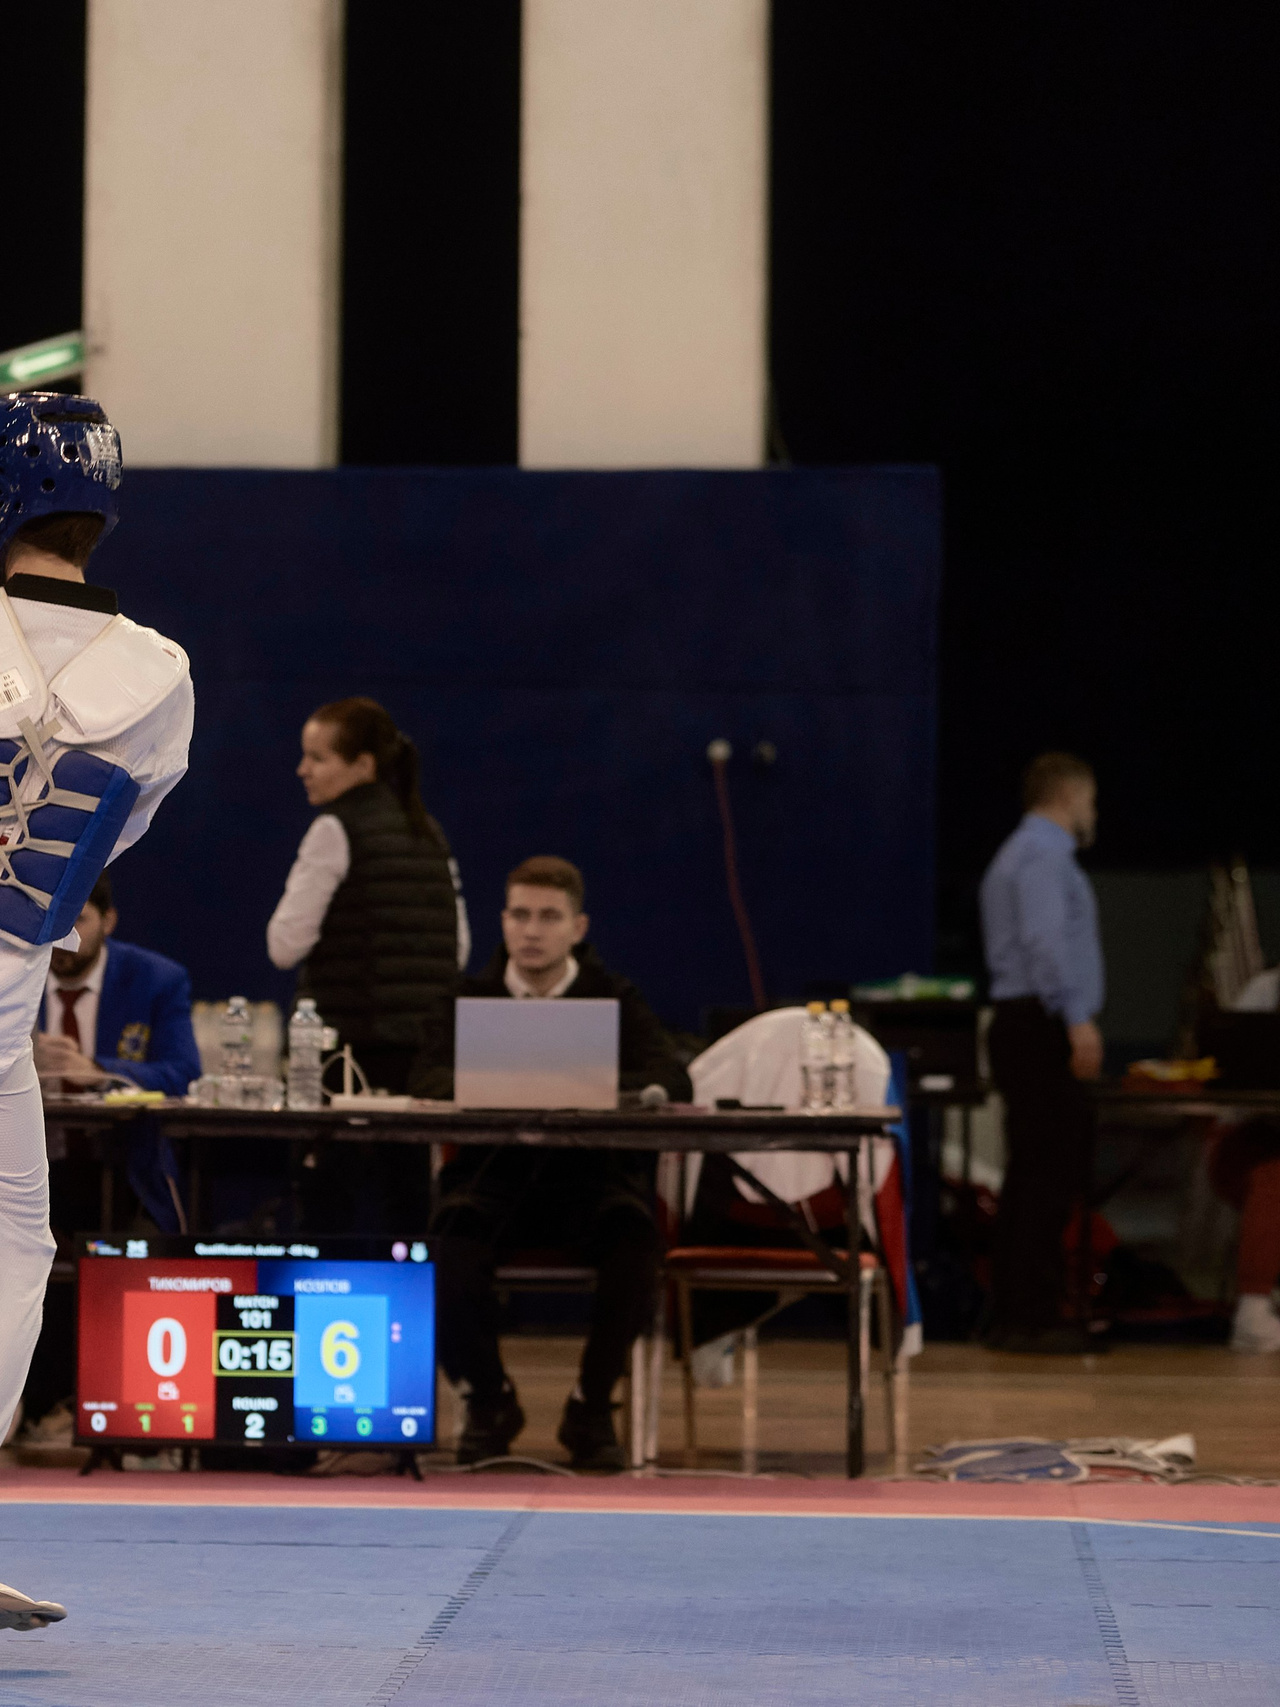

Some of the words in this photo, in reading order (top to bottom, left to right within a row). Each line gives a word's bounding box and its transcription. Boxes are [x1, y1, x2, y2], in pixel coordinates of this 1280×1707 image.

[239, 1309, 272, 1329] 101
[146, 1317, 187, 1377] 0
[219, 1338, 292, 1371] 0:15
[320, 1320, 360, 1379] 6
[232, 1396, 278, 1411] ROUND
[91, 1412, 107, 1433] 0
[139, 1413, 151, 1433] 1
[182, 1413, 194, 1434] 1
[244, 1412, 265, 1438] 2
[311, 1415, 328, 1436] 3
[356, 1416, 372, 1437] 0
[401, 1416, 418, 1438] 0
